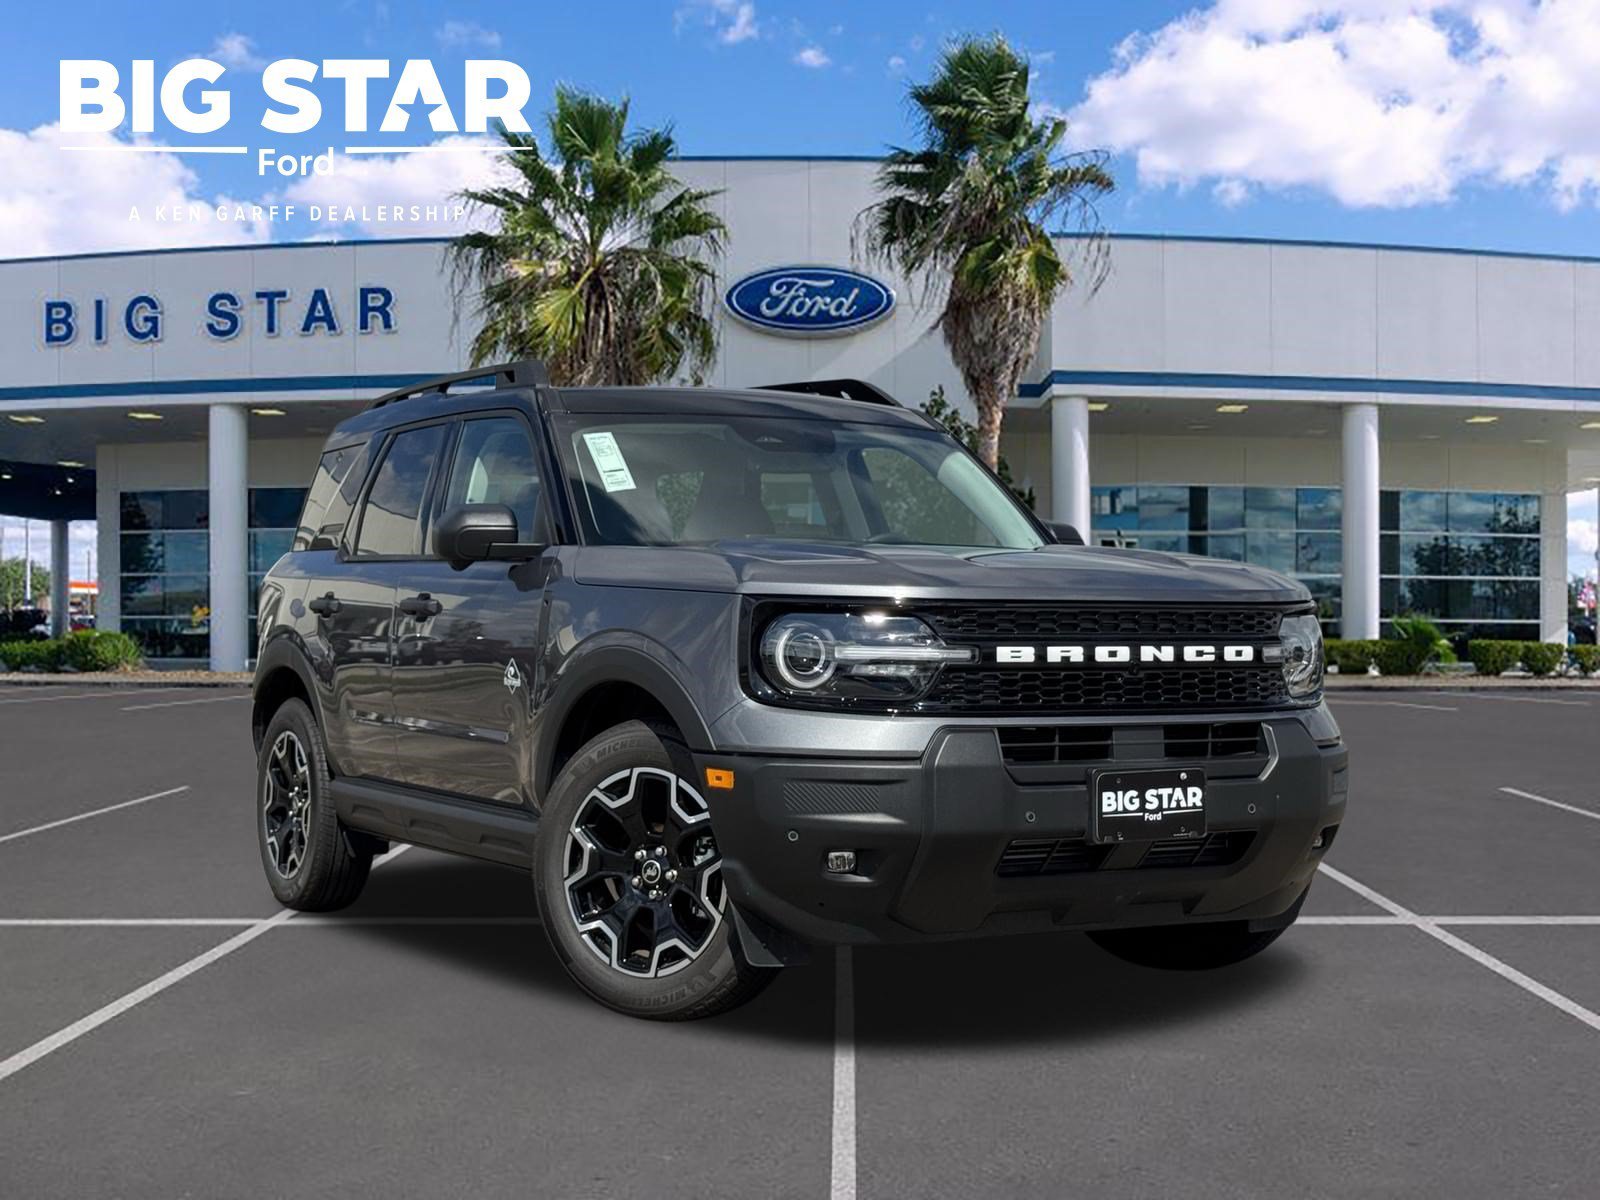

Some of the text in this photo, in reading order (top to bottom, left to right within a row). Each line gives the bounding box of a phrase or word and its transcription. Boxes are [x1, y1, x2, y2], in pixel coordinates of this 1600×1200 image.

[759, 277, 858, 318] Ford
[44, 286, 399, 346] BIG STAR
[996, 645, 1254, 663] BRONCO
[1101, 786, 1203, 813] BIG STAR
[1144, 811, 1162, 822] Ford
